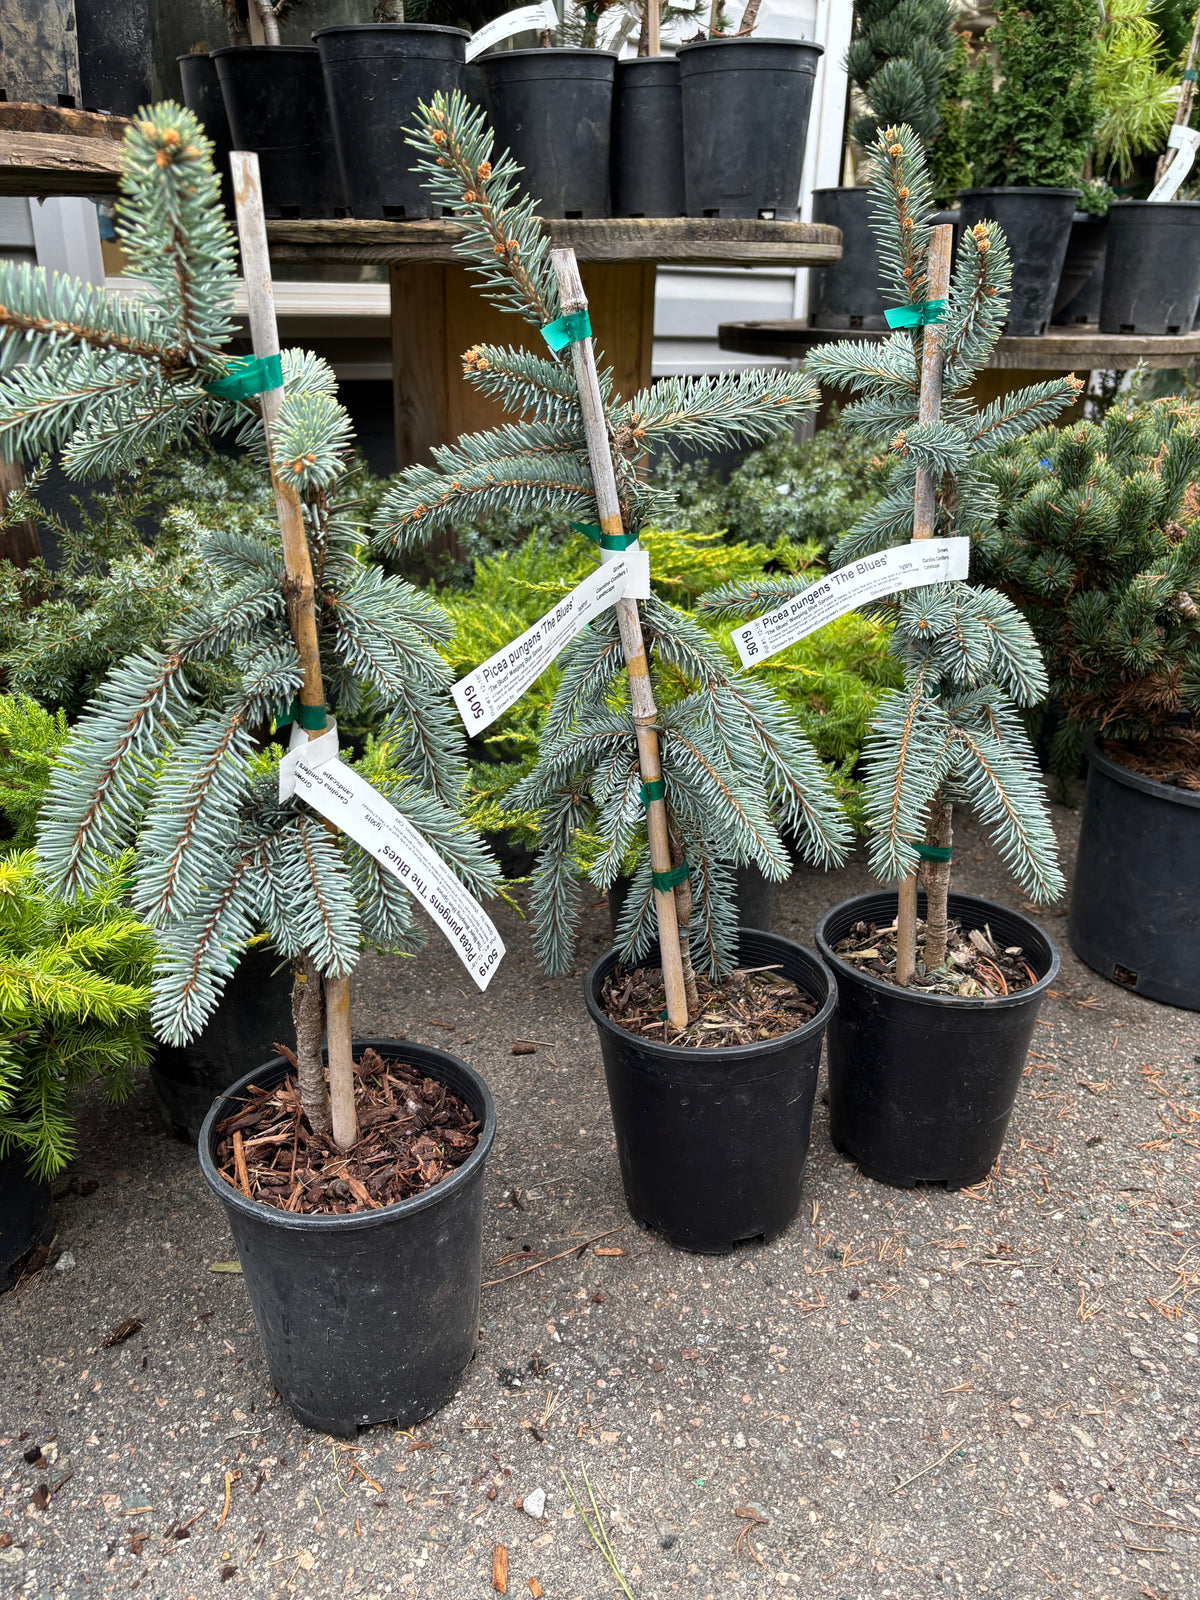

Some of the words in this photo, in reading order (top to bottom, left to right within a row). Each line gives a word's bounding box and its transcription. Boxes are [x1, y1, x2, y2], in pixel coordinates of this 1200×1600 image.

[762, 609, 789, 629] Picea
[790, 583, 831, 615] pungens
[830, 570, 855, 585] 'The
[855, 554, 887, 575] Blues'
[789, 609, 807, 623] Weeping
[808, 603, 818, 611] Blue
[818, 594, 834, 606] Spruce
[482, 658, 509, 683] Picea
[507, 631, 542, 667] pungens
[540, 617, 556, 634] 'The
[554, 597, 575, 622] Blues'
[741, 630, 759, 656] 5019
[463, 684, 486, 719] 5019
[293, 770, 312, 788] Grown
[298, 762, 323, 785] Conifers
[322, 771, 354, 799] Landscape
[323, 782, 348, 805] Carolina
[378, 845, 411, 877] Blues'
[410, 873, 427, 899] 'The
[428, 894, 463, 936] pungens
[459, 934, 477, 962] Picea
[478, 949, 500, 977] 5019
